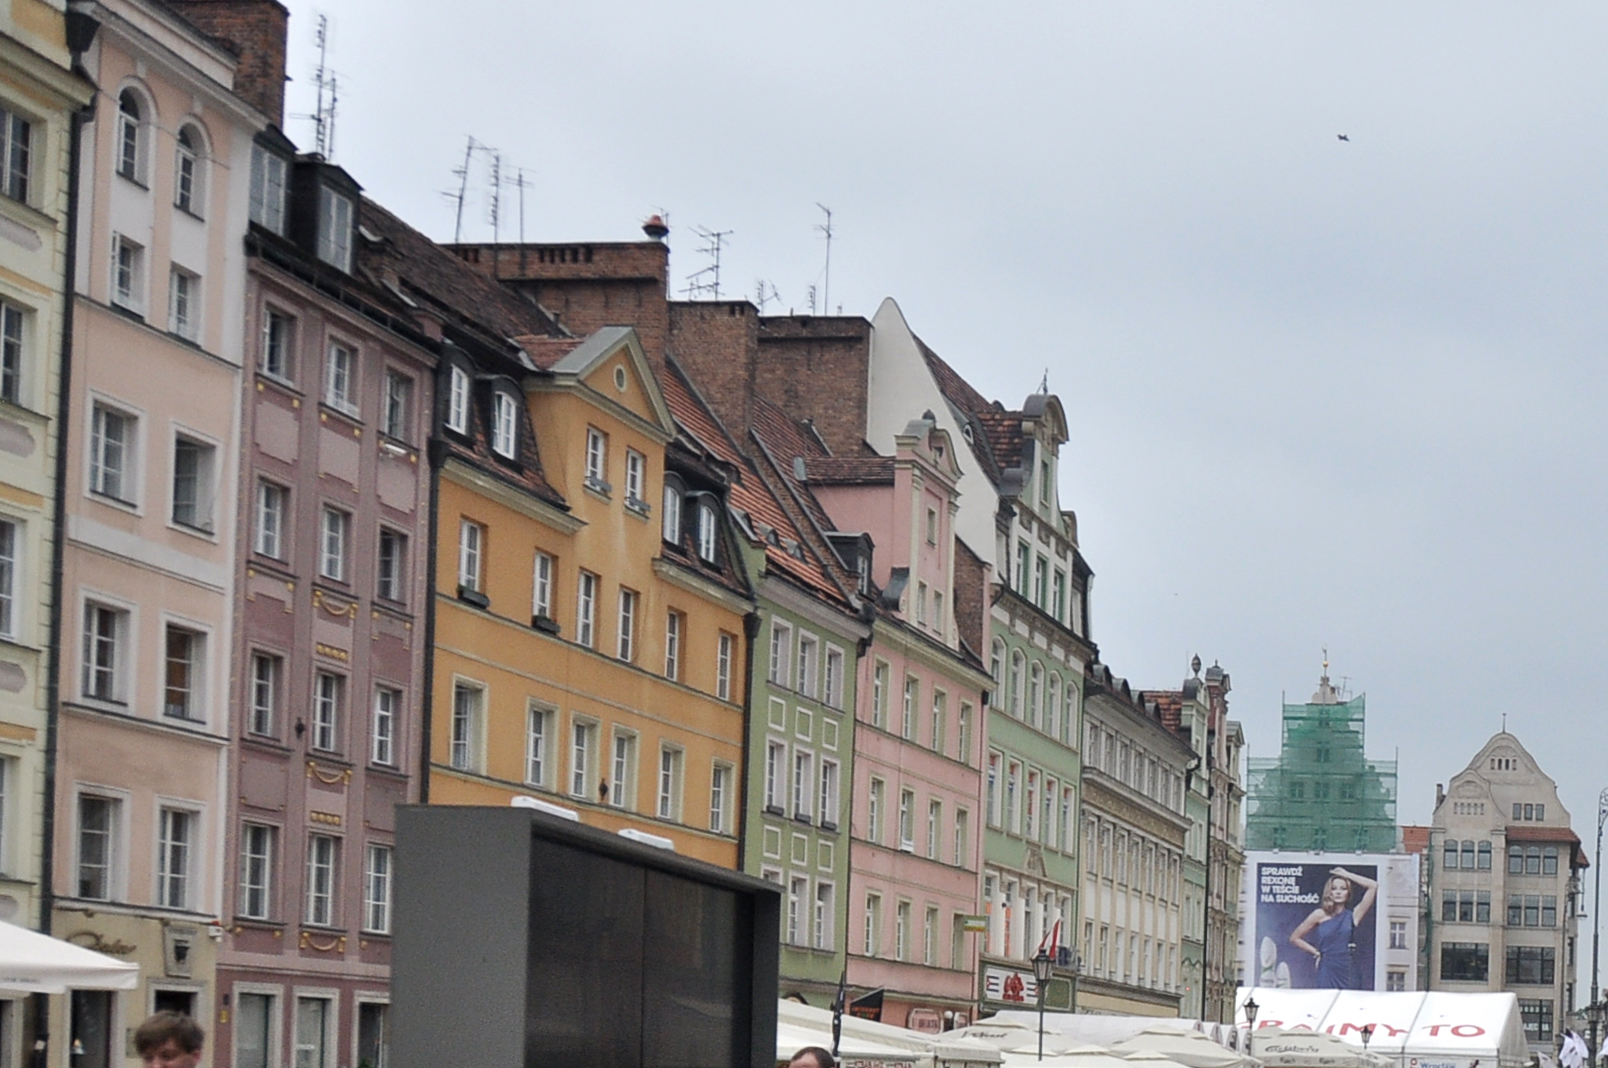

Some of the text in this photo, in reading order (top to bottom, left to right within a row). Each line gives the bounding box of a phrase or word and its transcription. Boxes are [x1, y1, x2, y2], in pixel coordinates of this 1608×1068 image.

[1261, 866, 1303, 876] SPRAWDŹ
[1261, 884, 1300, 894] W TEŚCIE
[1261, 893, 1320, 904] NA SUCHOŚĆ
[1422, 1024, 1486, 1038] TO
